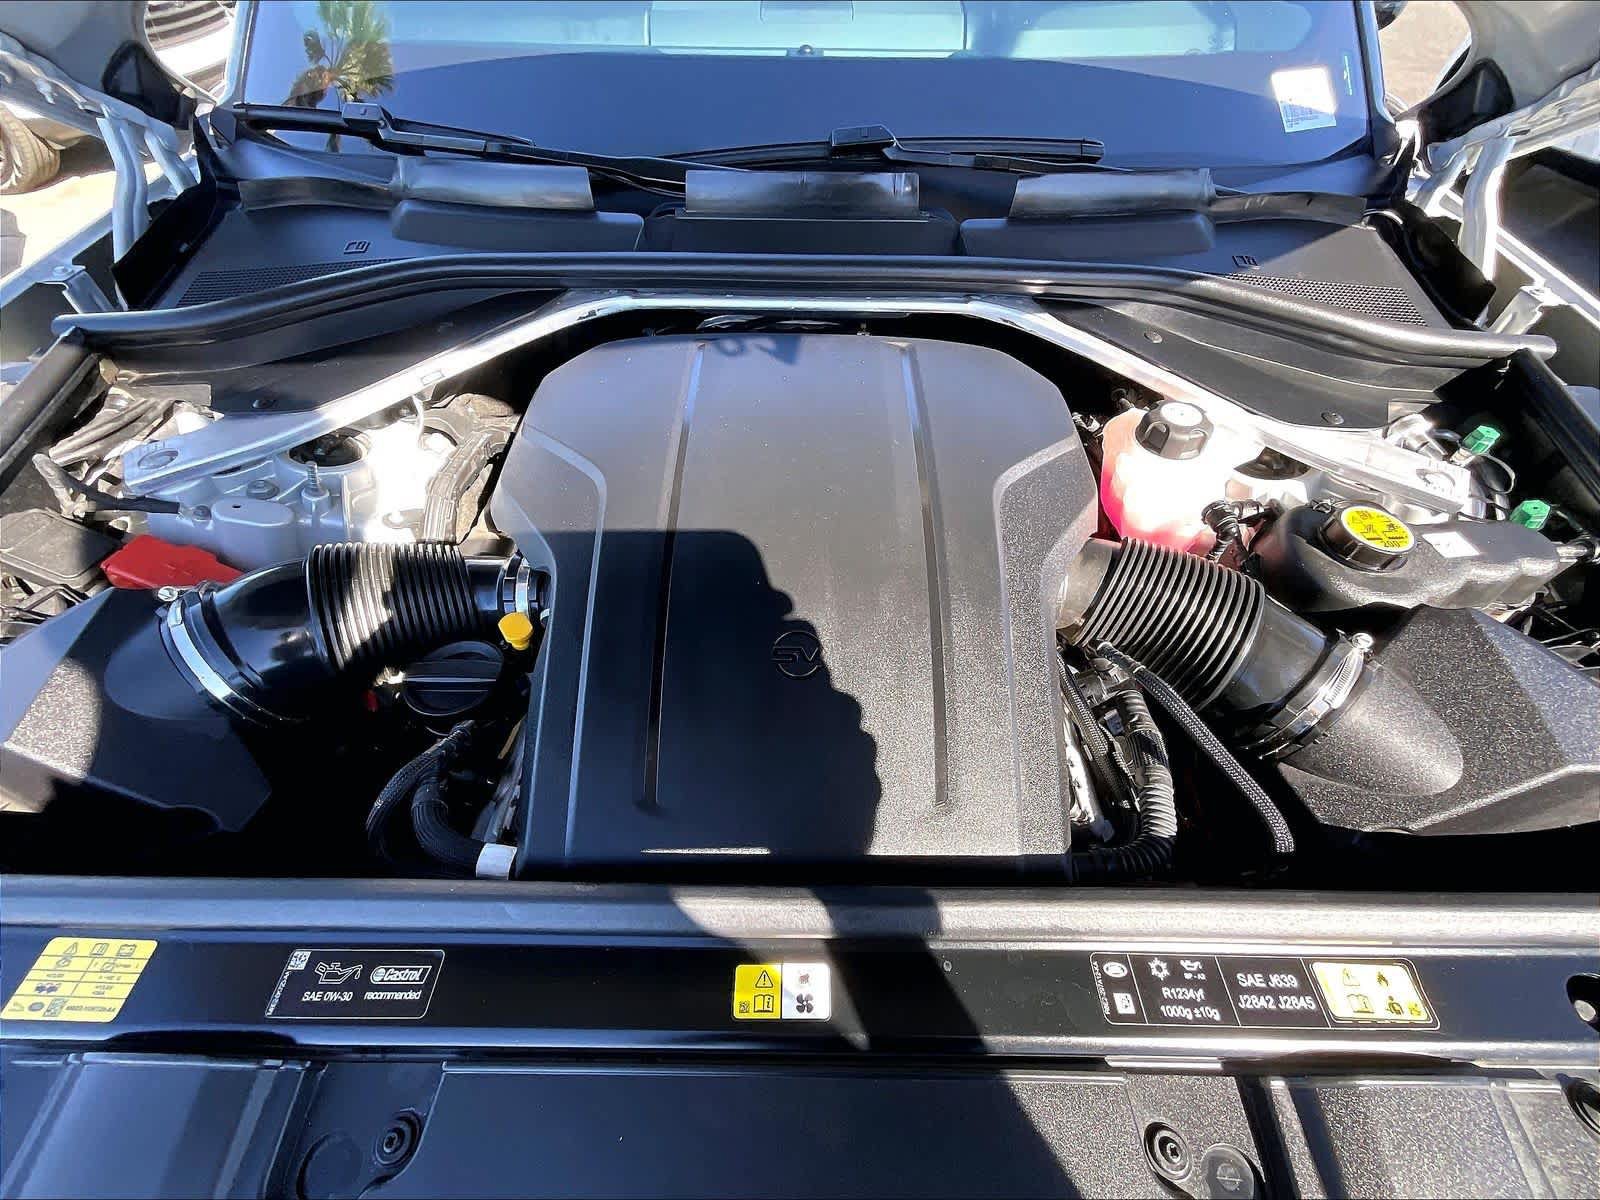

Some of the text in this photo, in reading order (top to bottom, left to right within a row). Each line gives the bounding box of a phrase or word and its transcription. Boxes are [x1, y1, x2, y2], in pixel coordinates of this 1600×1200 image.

[384, 968, 422, 982] Castrol
[1236, 973, 1298, 988] SAE J639
[302, 991, 353, 1002] SAE 0W-30
[364, 990, 422, 1000] recommended
[1161, 987, 1205, 1002] R1234yf
[1238, 994, 1316, 1010] J2842 J2845
[1160, 1005, 1221, 1021] 1000g ±10g
